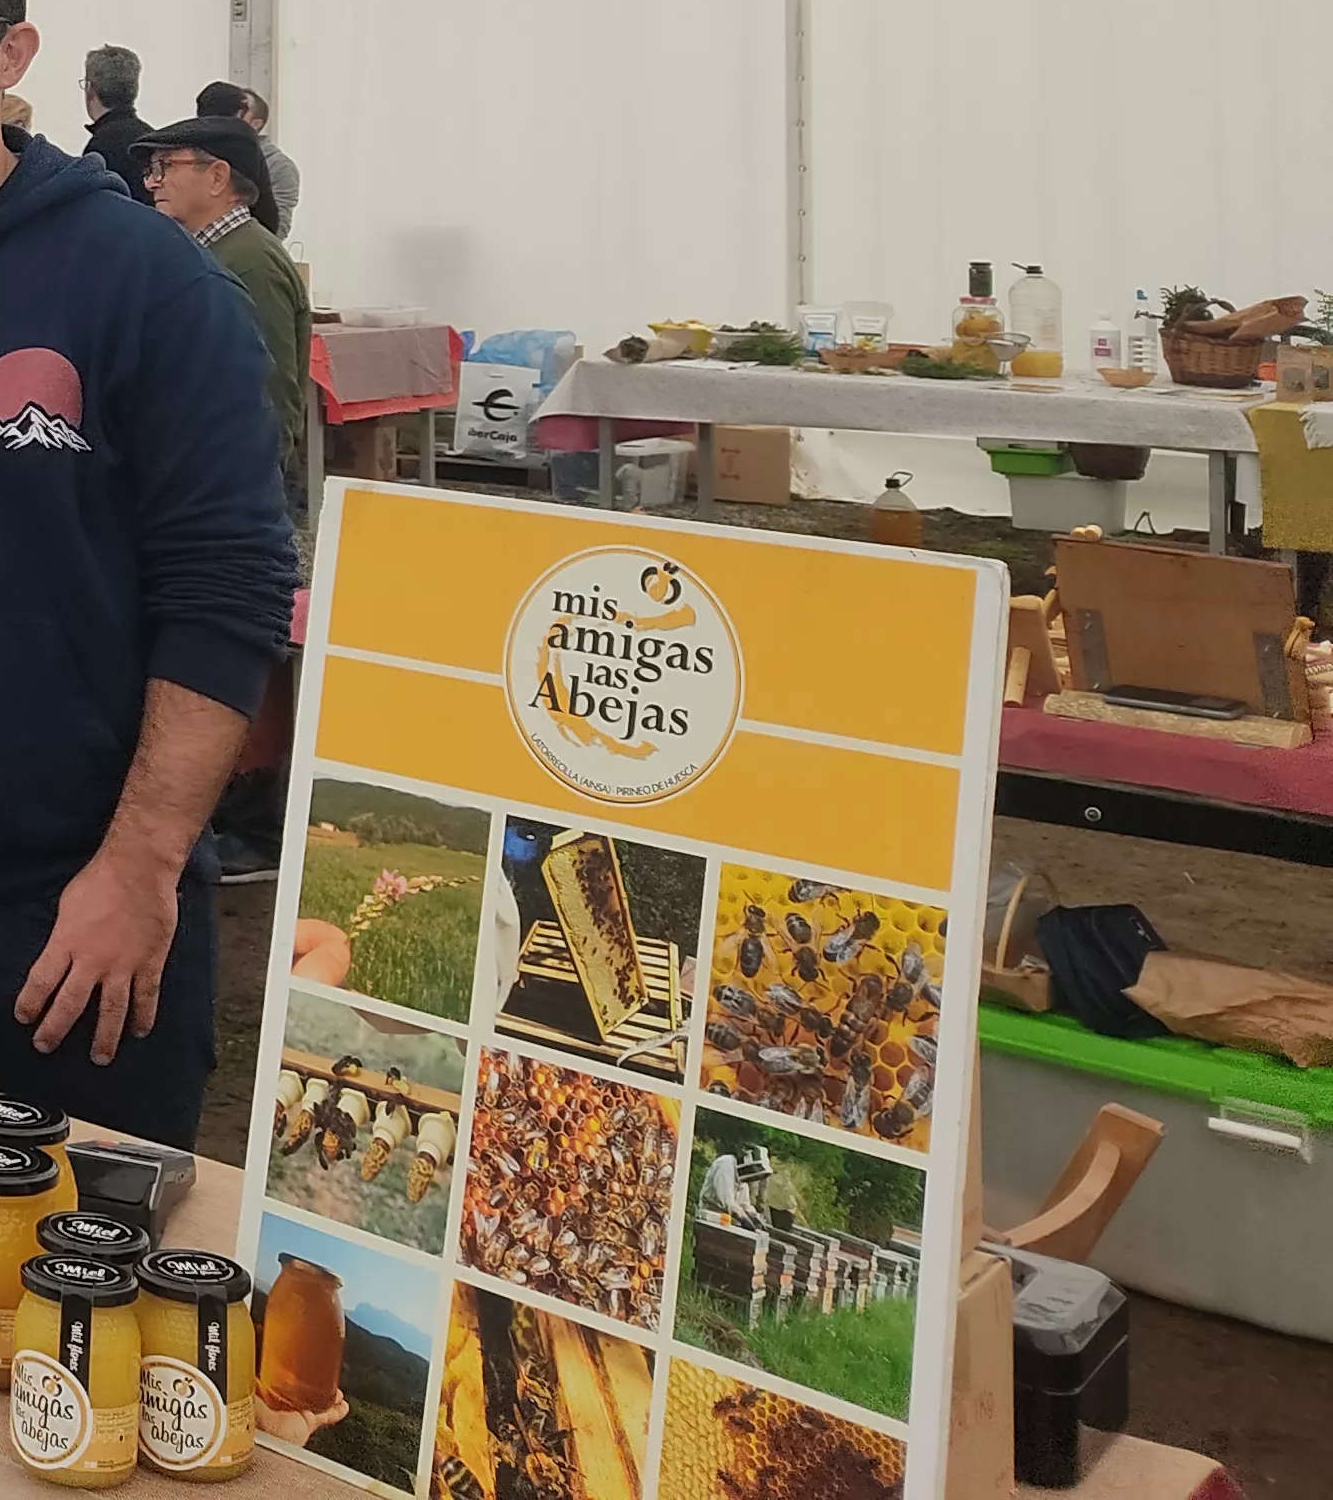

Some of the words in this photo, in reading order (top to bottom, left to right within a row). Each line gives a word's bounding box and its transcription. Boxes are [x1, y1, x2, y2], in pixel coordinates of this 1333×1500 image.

[551, 584, 618, 622] mis
[547, 619, 714, 683] amigas
[585, 661, 629, 690] las
[527, 671, 689, 741] Abejas
[616, 785, 652, 797] PIRINEO
[651, 781, 665, 793] DE
[663, 763, 699, 788] HUESCA
[71, 1219, 121, 1238] Miel
[56, 1262, 106, 1278] Miel
[166, 1259, 217, 1273] Miel
[70, 1320, 84, 1344] Mil
[208, 1320, 221, 1344] Mil
[66, 1342, 84, 1372] flores
[205, 1342, 221, 1372] flores
[13, 1380, 74, 1430] amigas
[21, 1416, 69, 1453] abejas
[151, 1420, 205, 1455] abejas
